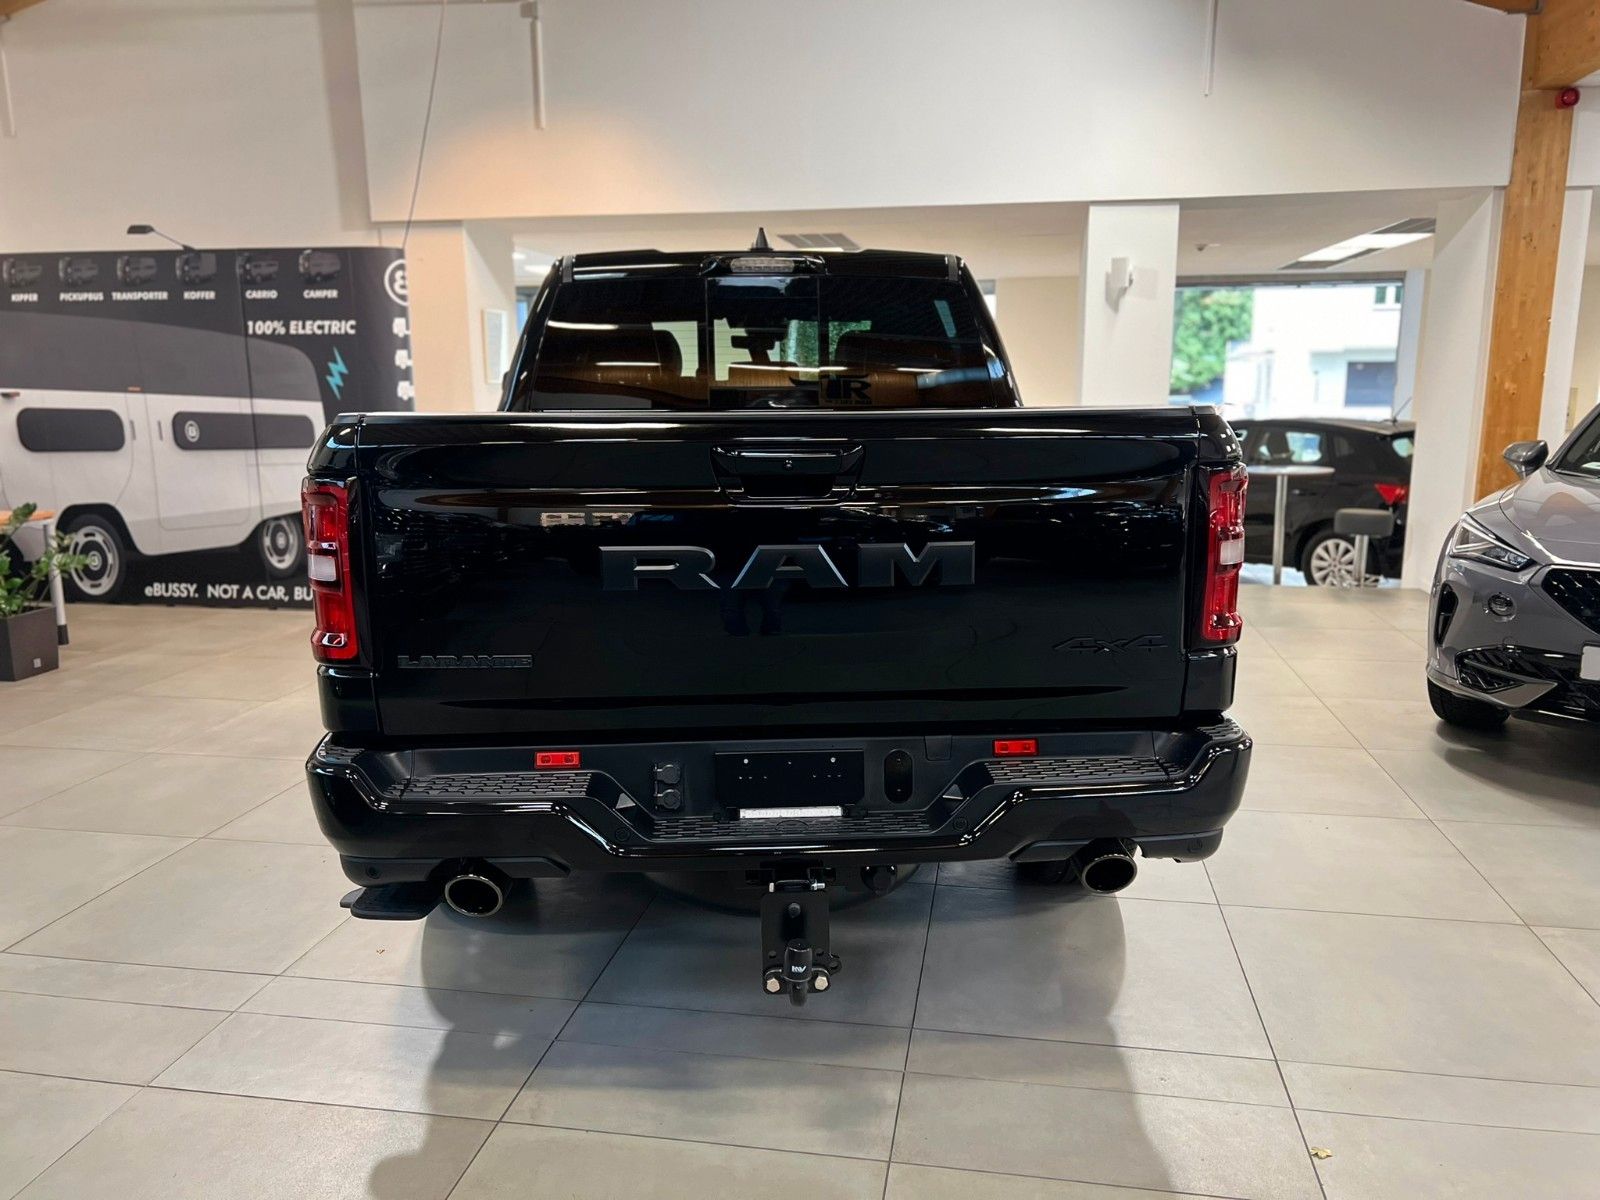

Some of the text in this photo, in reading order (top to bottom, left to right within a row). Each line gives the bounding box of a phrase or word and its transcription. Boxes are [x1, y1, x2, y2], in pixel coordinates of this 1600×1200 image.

[11, 293, 38, 302] KIPPER
[59, 292, 104, 301] PICKUPBUS
[112, 291, 168, 300] TRANSPORTER
[183, 290, 216, 300] KOFFER
[245, 289, 278, 299] CABRIO
[303, 289, 338, 299] CAMPER
[247, 319, 356, 335] 100% ELECTRIC
[600, 541, 975, 591] RAM
[144, 582, 198, 598] eBUSSY.
[207, 584, 239, 599] NOT
[242, 585, 254, 599] A
[256, 585, 289, 602] CAR,
